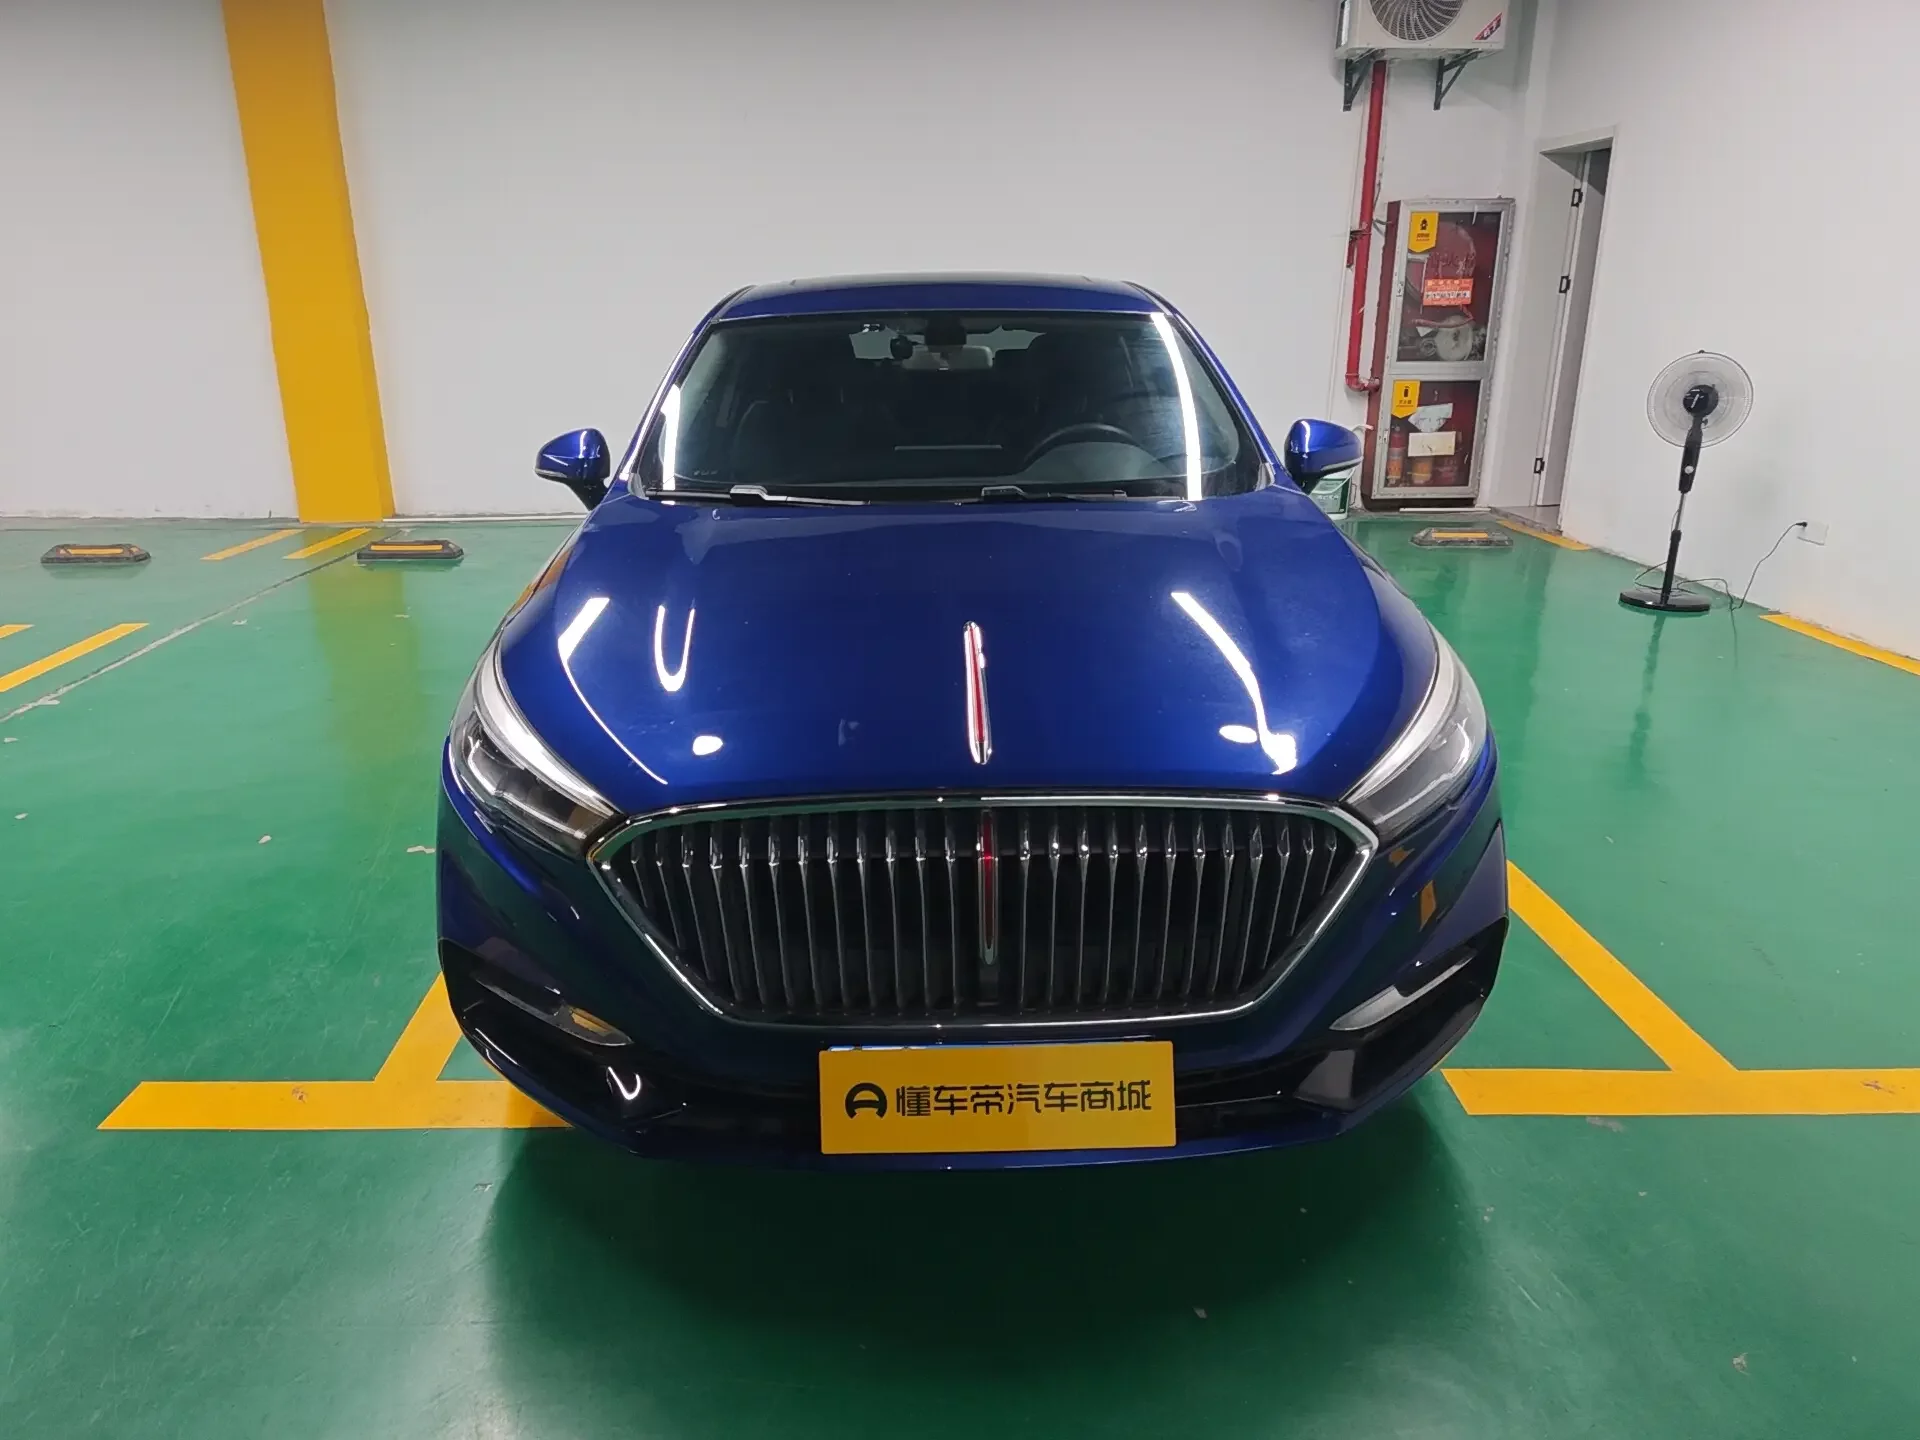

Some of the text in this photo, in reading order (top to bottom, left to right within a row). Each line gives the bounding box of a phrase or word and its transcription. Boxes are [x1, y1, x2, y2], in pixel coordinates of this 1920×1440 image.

[896, 1080, 1152, 1117] 懂车帝汽车商城
